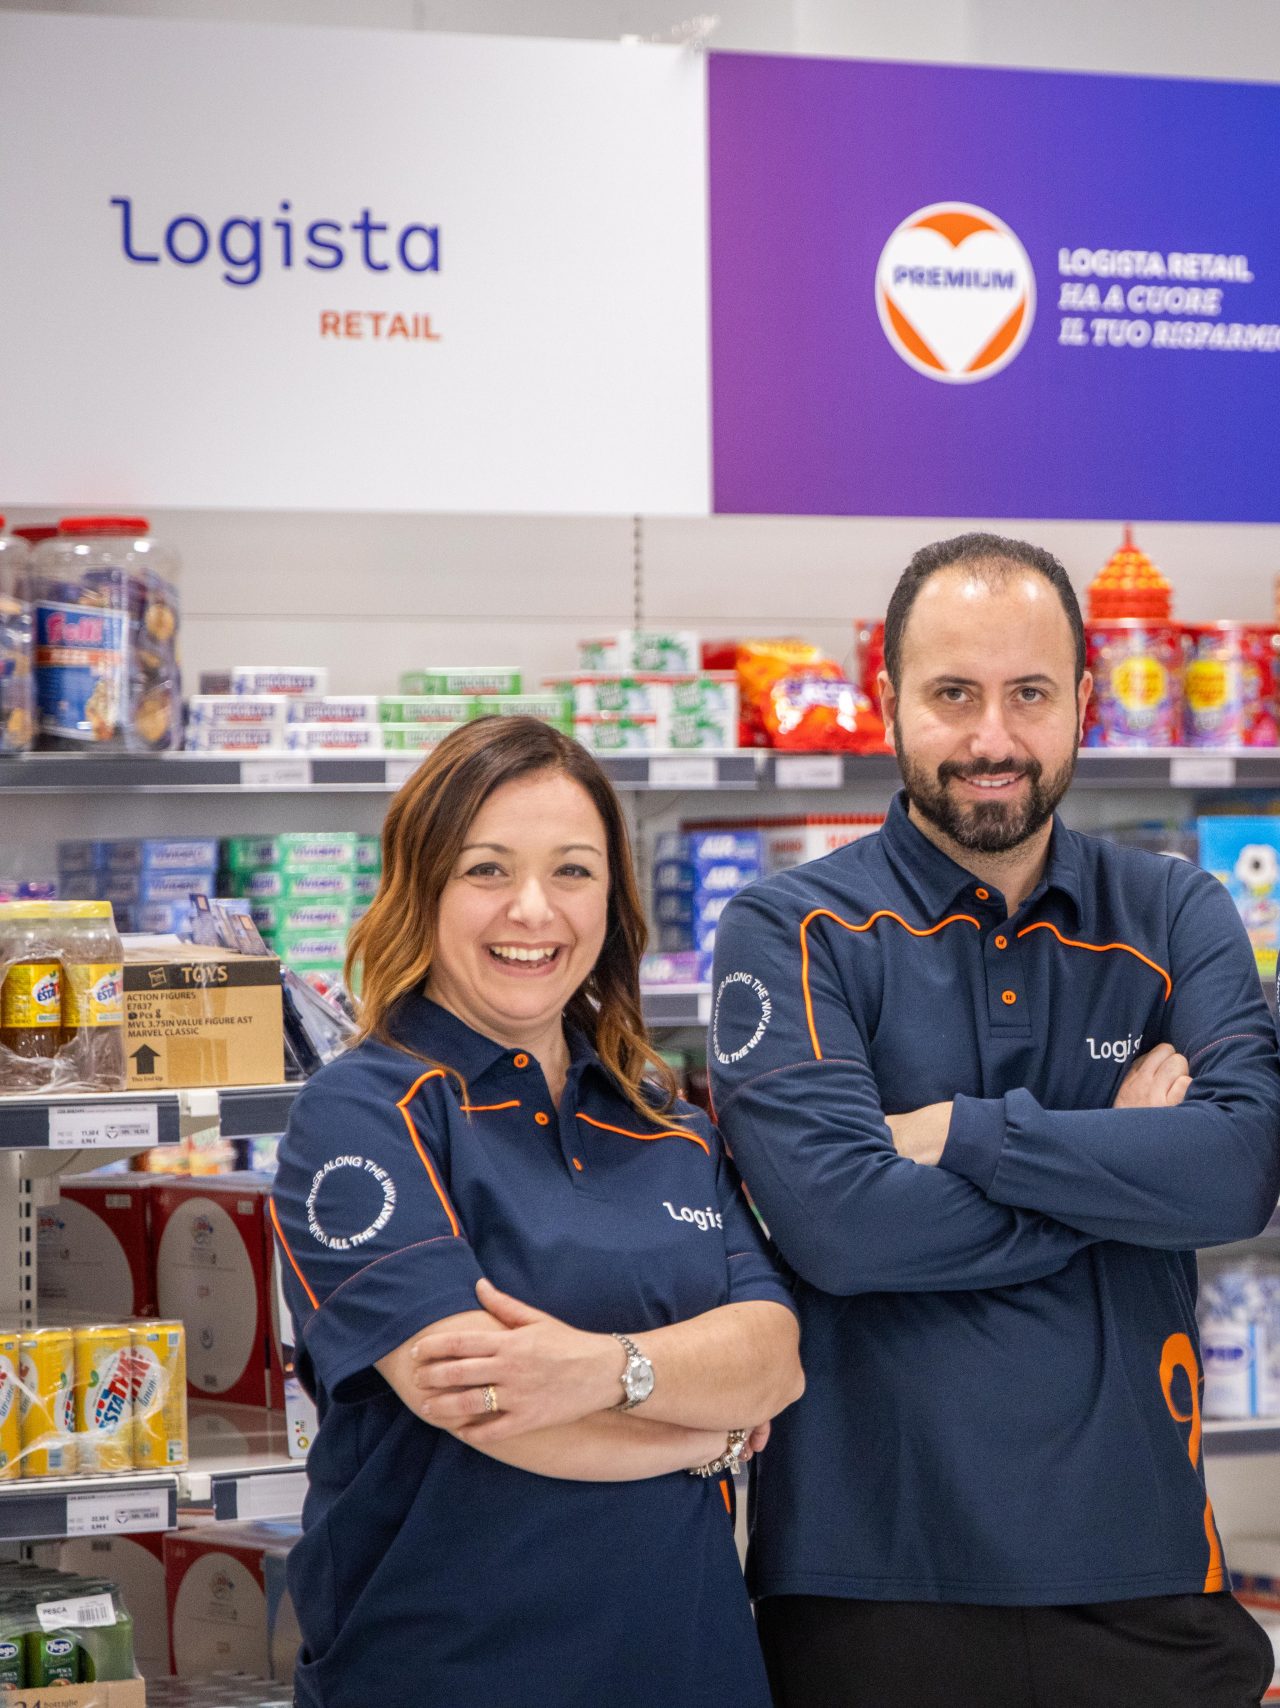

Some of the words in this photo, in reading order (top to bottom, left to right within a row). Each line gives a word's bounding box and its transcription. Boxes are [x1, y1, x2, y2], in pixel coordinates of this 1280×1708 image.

[110, 196, 442, 286] logista
[893, 265, 1016, 289] PREMIUM
[1058, 248, 1167, 280] LOGISTA
[1168, 252, 1254, 284] RETAIL
[1058, 283, 1100, 312] HA
[1101, 285, 1126, 313] A
[1127, 285, 1224, 316] CUORE
[320, 311, 442, 342] RETAIL
[1058, 317, 1089, 346] IL
[1090, 319, 1152, 348] TUO
[181, 966, 228, 984] TOYS
[161, 992, 196, 1000] FIGURES
[725, 972, 752, 984] ALONG
[752, 978, 769, 1000] THE
[762, 999, 772, 1024] WAY
[128, 1030, 162, 1038] MARVEL
[165, 1028, 200, 1036] CLASSIC
[205, 1017, 235, 1026] FIGURE
[237, 1016, 252, 1024] AST
[718, 1053, 730, 1064] ALL
[730, 1045, 749, 1062] THE
[747, 1022, 766, 1048] WAY
[309, 1221, 329, 1246] YOUR
[324, 1156, 363, 1174] ALONG
[364, 1159, 388, 1182] THE
[381, 1178, 396, 1204] WAY
[329, 1237, 351, 1250] ALL
[349, 1226, 378, 1247] THE
[372, 1202, 395, 1230] WAY
